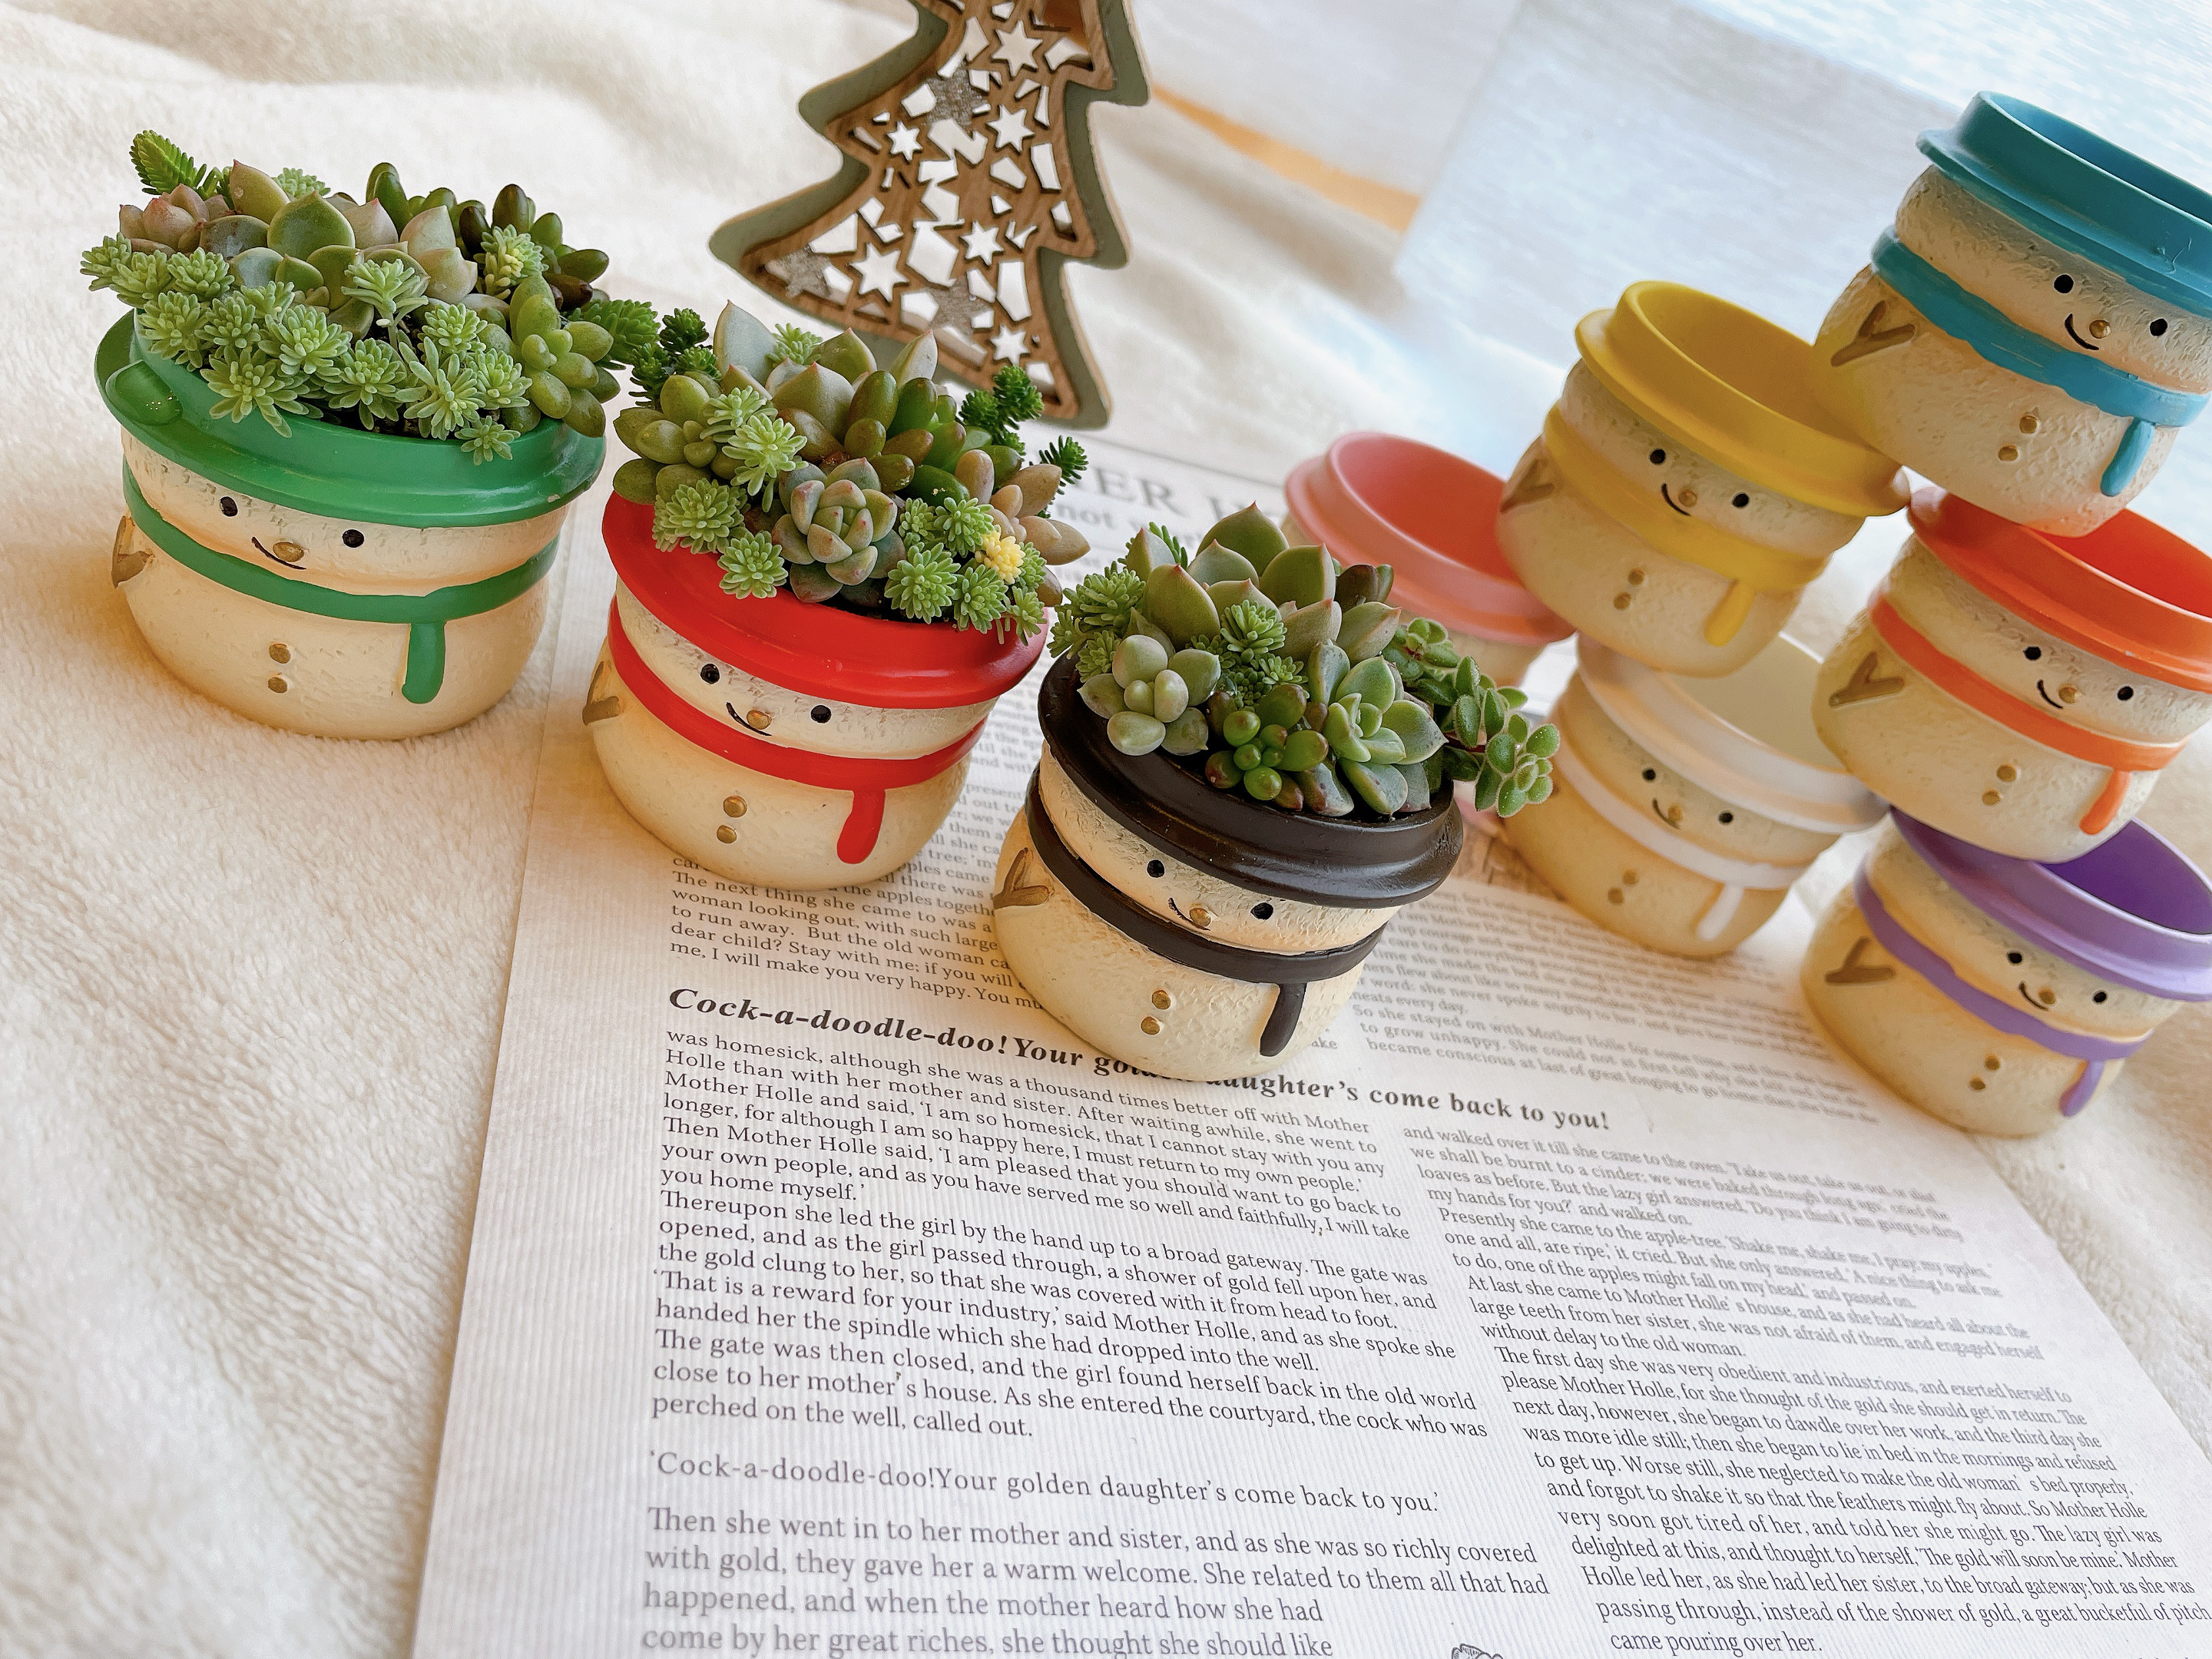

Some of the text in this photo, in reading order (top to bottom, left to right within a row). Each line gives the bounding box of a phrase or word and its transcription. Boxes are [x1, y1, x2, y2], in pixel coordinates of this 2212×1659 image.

[945, 868, 990, 883] came
[951, 885, 985, 899] was
[672, 870, 992, 933] The next thing she came to was a
[876, 887, 932, 906] apples
[672, 889, 999, 952] woman looking out, with such large
[1366, 1038, 1432, 1056] became
[666, 1048, 1377, 1154] Holle than with her mother and sister. After waiting awhile, she went to
[1012, 1037, 1083, 1066] Your
[1206, 1074, 1359, 1101] aughter's
[1369, 1088, 1441, 1110] come
[1450, 1091, 1512, 1118] back
[1521, 1101, 1545, 1122] to
[1553, 1110, 1609, 1131] you!
[661, 1169, 702, 1186] you
[710, 1169, 773, 1192] home
[1427, 1189, 1452, 1205] my
[1454, 1187, 1507, 1207] hands
[1508, 1193, 1531, 1210] for
[1580, 1203, 1609, 1217] and
[1611, 1206, 1667, 1223] walked
[659, 1221, 1437, 1310] opened, and as the girl passed through, a shower of gold fell upon her, and
[1452, 1253, 1472, 1267] to
[1504, 1260, 1535, 1273] one
[1538, 1259, 1556, 1274] of
[1557, 1260, 1585, 1277] the
[1589, 1266, 1641, 1285] apples
[1642, 1270, 1690, 1289] might
[1690, 1272, 1717, 1289] fall
[1718, 1280, 1740, 1291] on
[1740, 1281, 1765, 1298] my
[1480, 1323, 1747, 1356] without delay to the old woman.
[651, 1393, 1032, 1437] perched on the well, called out.
[1512, 1399, 2102, 1452] next day, however, she began to dawdle over her work, and the third day she
[1007, 1472, 1091, 1499] golden
[1099, 1475, 1227, 1505] daughter's
[1234, 1488, 1295, 1505] come
[1300, 1485, 1356, 1508] back
[1362, 1491, 1386, 1509] to
[1391, 1492, 1438, 1516] you.'
[1558, 1512, 2163, 1548] very soon got tired of her, and told her she might go. The lazy girl was
[642, 1581, 1323, 1621] happened, and when the mother heard how she had
[1610, 1631, 1823, 1657] came pouring over her.
